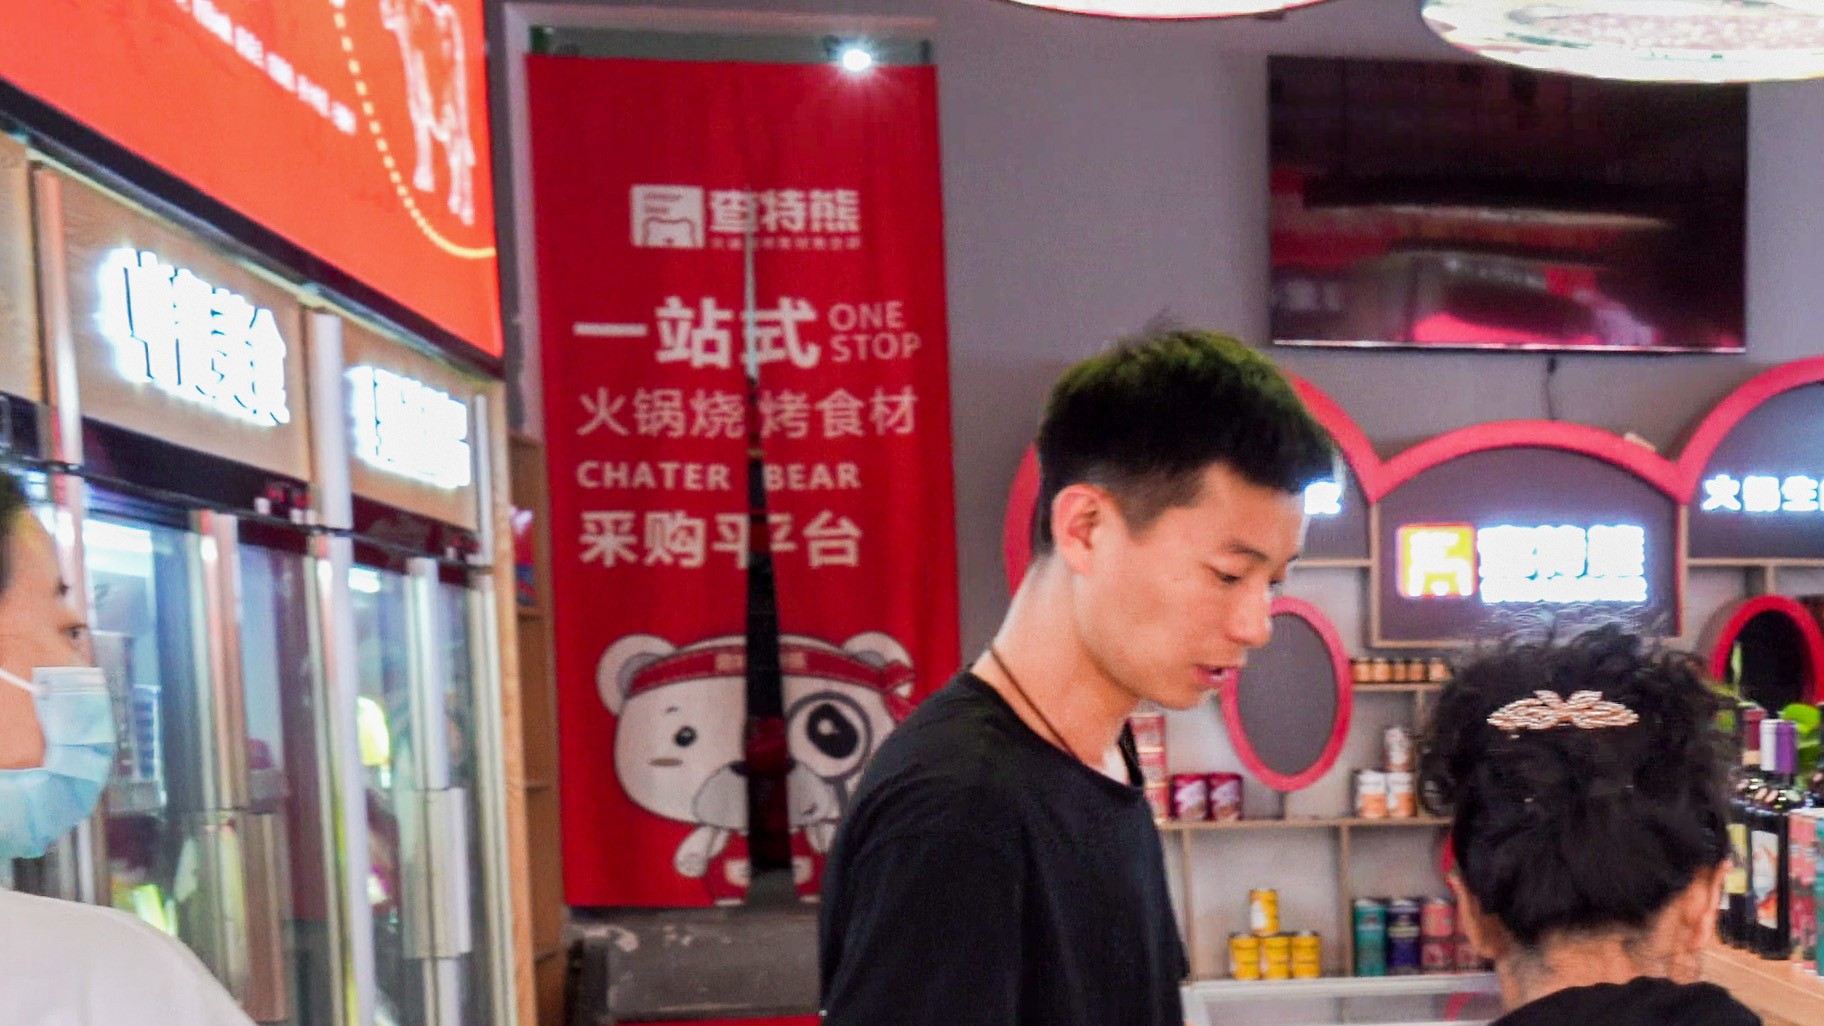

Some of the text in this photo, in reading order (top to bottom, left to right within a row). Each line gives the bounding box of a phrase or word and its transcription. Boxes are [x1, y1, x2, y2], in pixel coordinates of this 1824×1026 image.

[709, 188, 860, 233] 查特熊
[573, 297, 821, 370] 一站式
[828, 302, 904, 330] ONE
[831, 332, 922, 362] STOP
[576, 386, 919, 438] 火锅烧烤食材
[576, 460, 861, 491] CHATER BEAR
